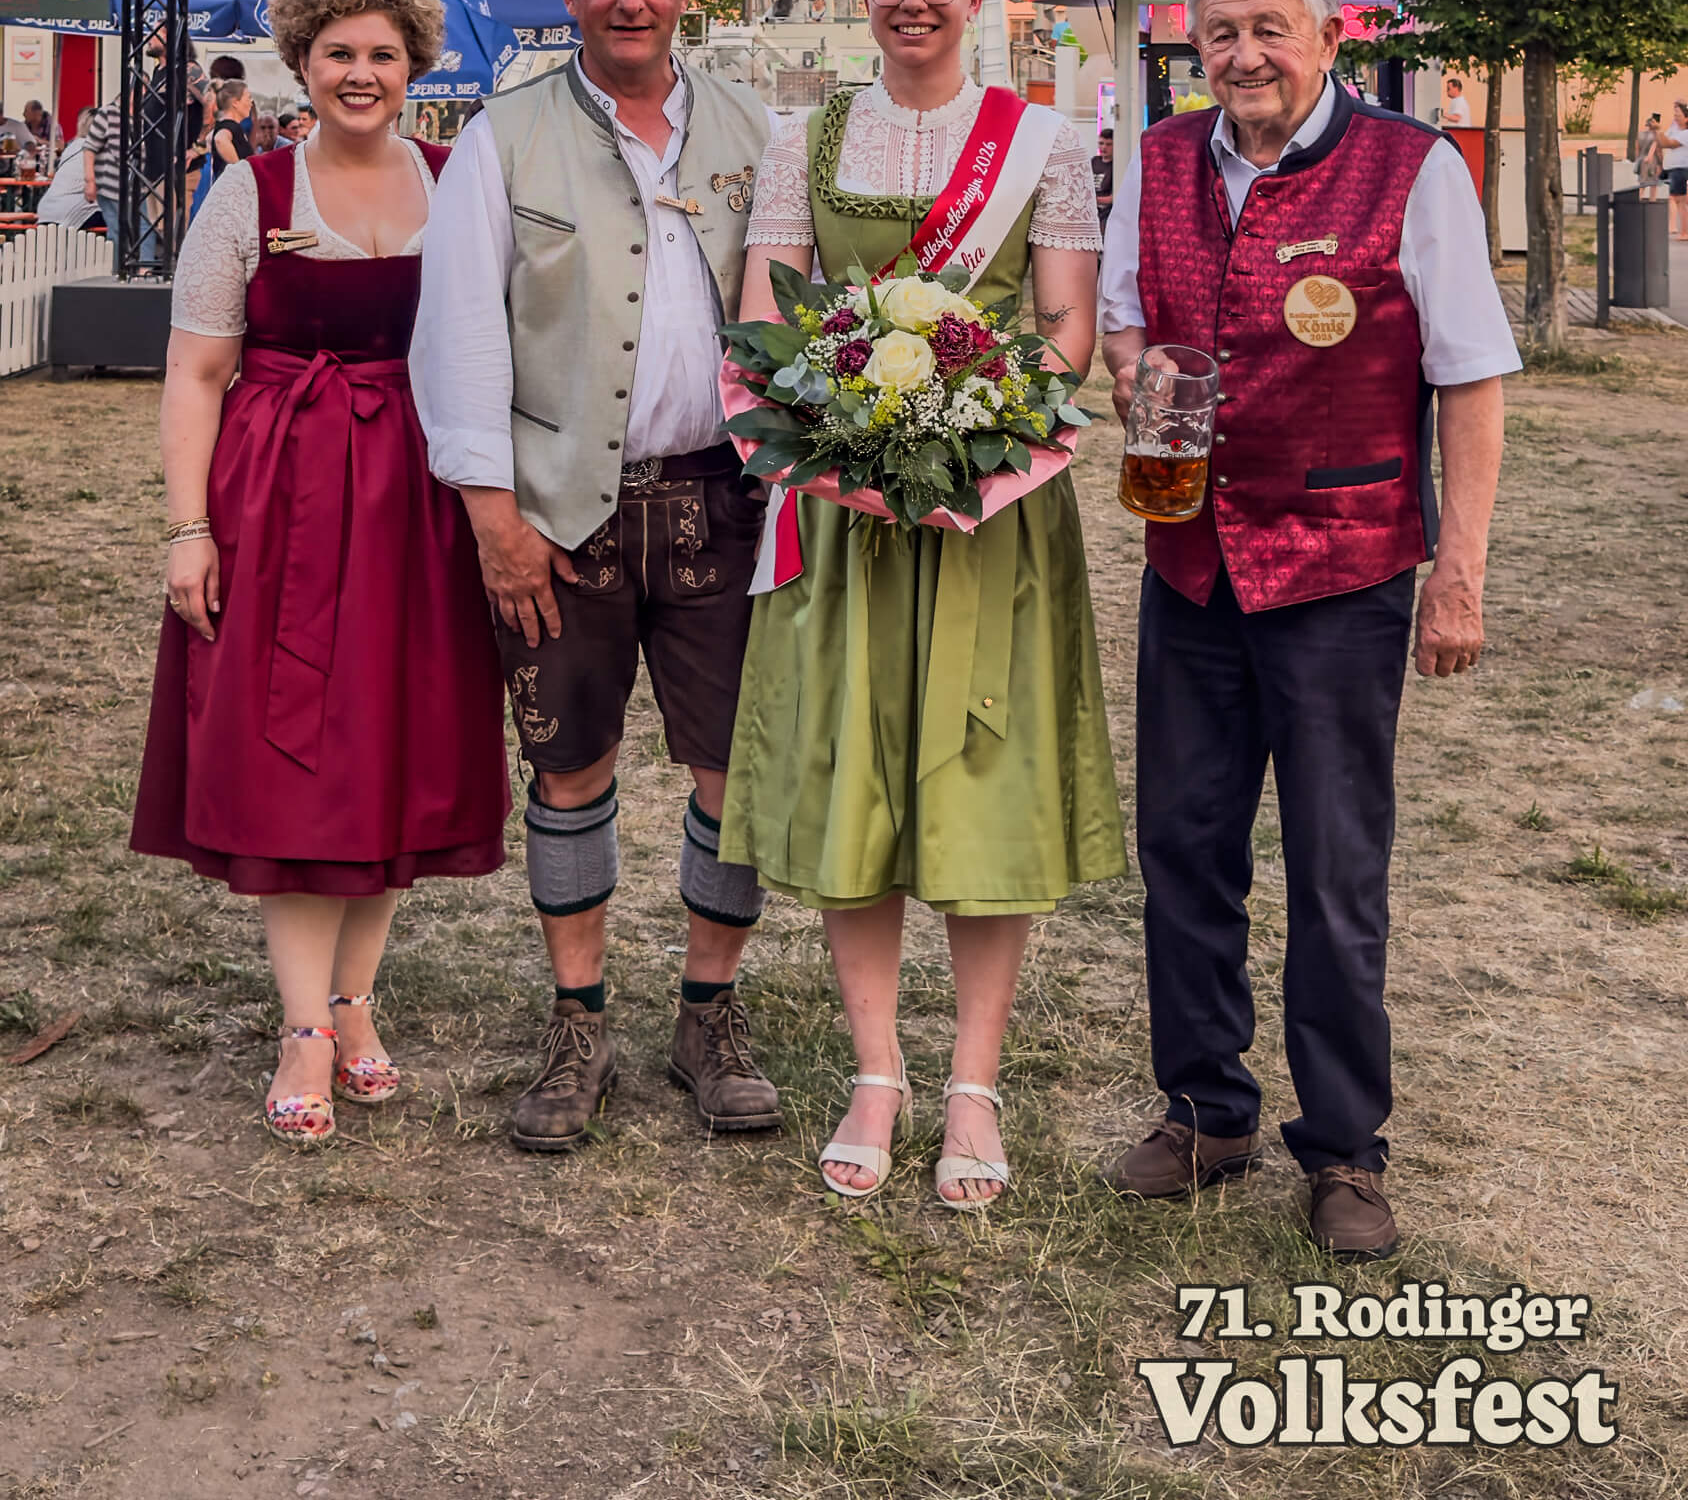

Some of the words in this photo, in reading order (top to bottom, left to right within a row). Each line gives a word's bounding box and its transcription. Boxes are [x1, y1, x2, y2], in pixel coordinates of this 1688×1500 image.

[541, 25, 582, 45] BIER
[456, 82, 487, 96] BIER
[972, 140, 998, 176] 2026
[960, 246, 986, 274] lia
[1296, 319, 1346, 336] König
